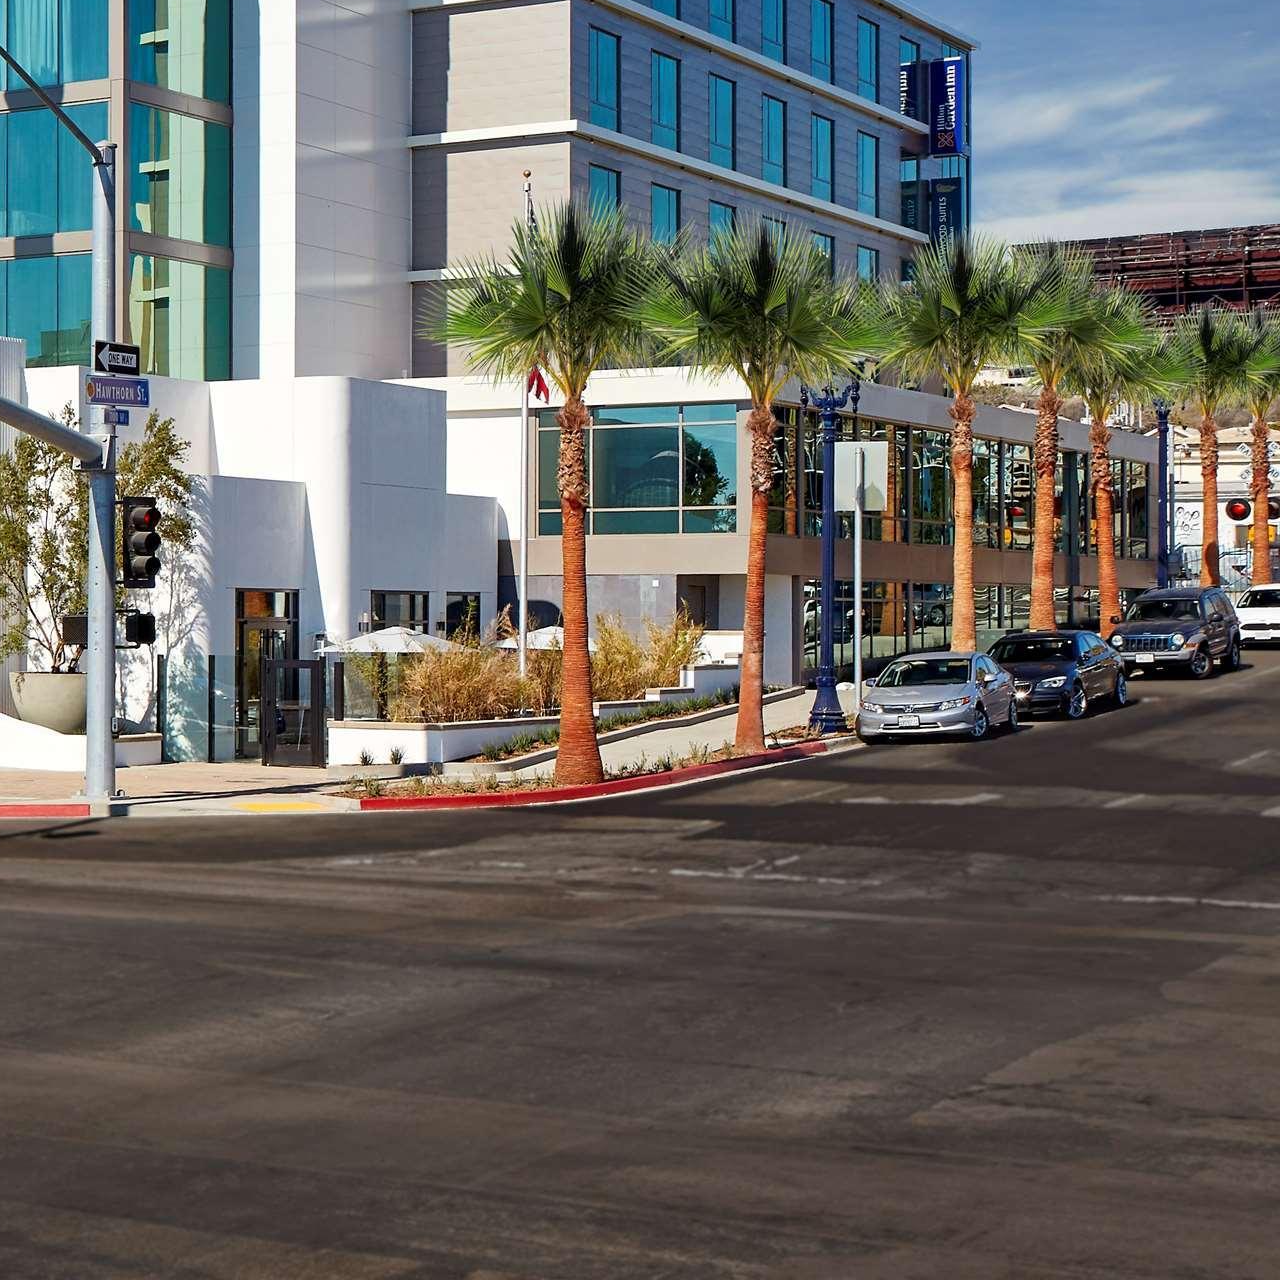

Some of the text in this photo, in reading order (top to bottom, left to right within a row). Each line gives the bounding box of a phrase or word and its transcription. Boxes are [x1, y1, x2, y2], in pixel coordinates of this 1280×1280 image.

[945, 65, 955, 130] Garden Inn
[938, 196, 947, 222] SUITES
[108, 352, 133, 365] ONE WAY
[95, 383, 134, 400] HAWTHORN
